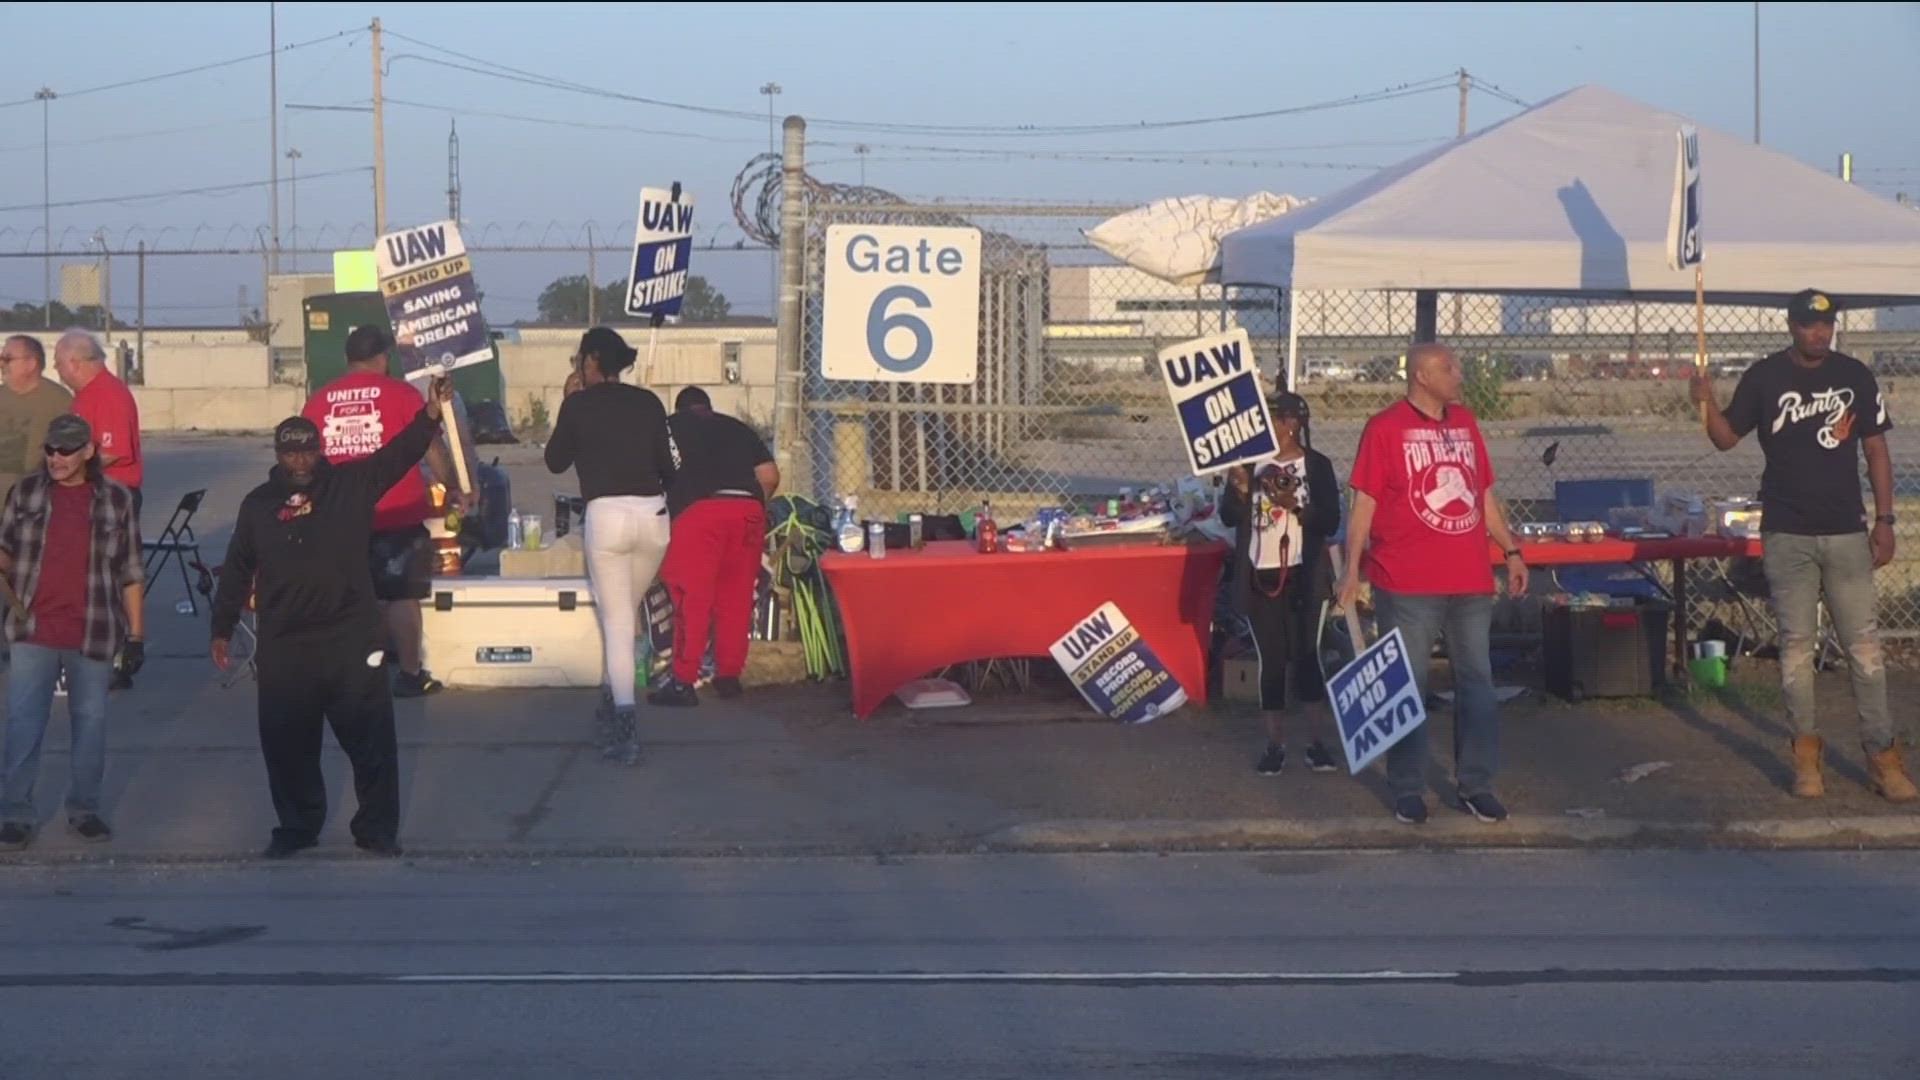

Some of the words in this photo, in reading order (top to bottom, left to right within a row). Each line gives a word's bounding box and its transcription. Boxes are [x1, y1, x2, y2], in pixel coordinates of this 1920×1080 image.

[643, 200, 693, 234] UAW
[386, 225, 446, 268] UAW
[654, 242, 677, 276] ON
[846, 234, 963, 276] Gate
[388, 269, 439, 293] STAND
[444, 261, 464, 274] UP
[632, 269, 687, 309] STRIKE
[397, 301, 478, 337] AMERICAN
[403, 285, 462, 314] SAVING
[413, 320, 469, 348] DREAM
[866, 284, 933, 374] 6
[1165, 341, 1241, 388] UAW
[326, 387, 381, 402] UNITED
[339, 406, 358, 416] FOR
[1204, 386, 1236, 425] ON
[1772, 387, 1855, 434] Runtz
[325, 432, 381, 447] STRONG
[1193, 405, 1265, 465] STRIKE
[1402, 441, 1432, 479] FOR
[1061, 610, 1113, 660] UAW
[1077, 646, 1116, 681] STAND
[1116, 632, 1132, 648] UP
[1095, 651, 1138, 688] RECORD
[1102, 659, 1145, 697] PROFITS
[1109, 670, 1169, 718] CONTRACTS
[1110, 669, 1153, 706] RECORD
[1337, 639, 1399, 715] STRIKE
[1360, 678, 1387, 717] ON
[1355, 695, 1419, 762] UAW
